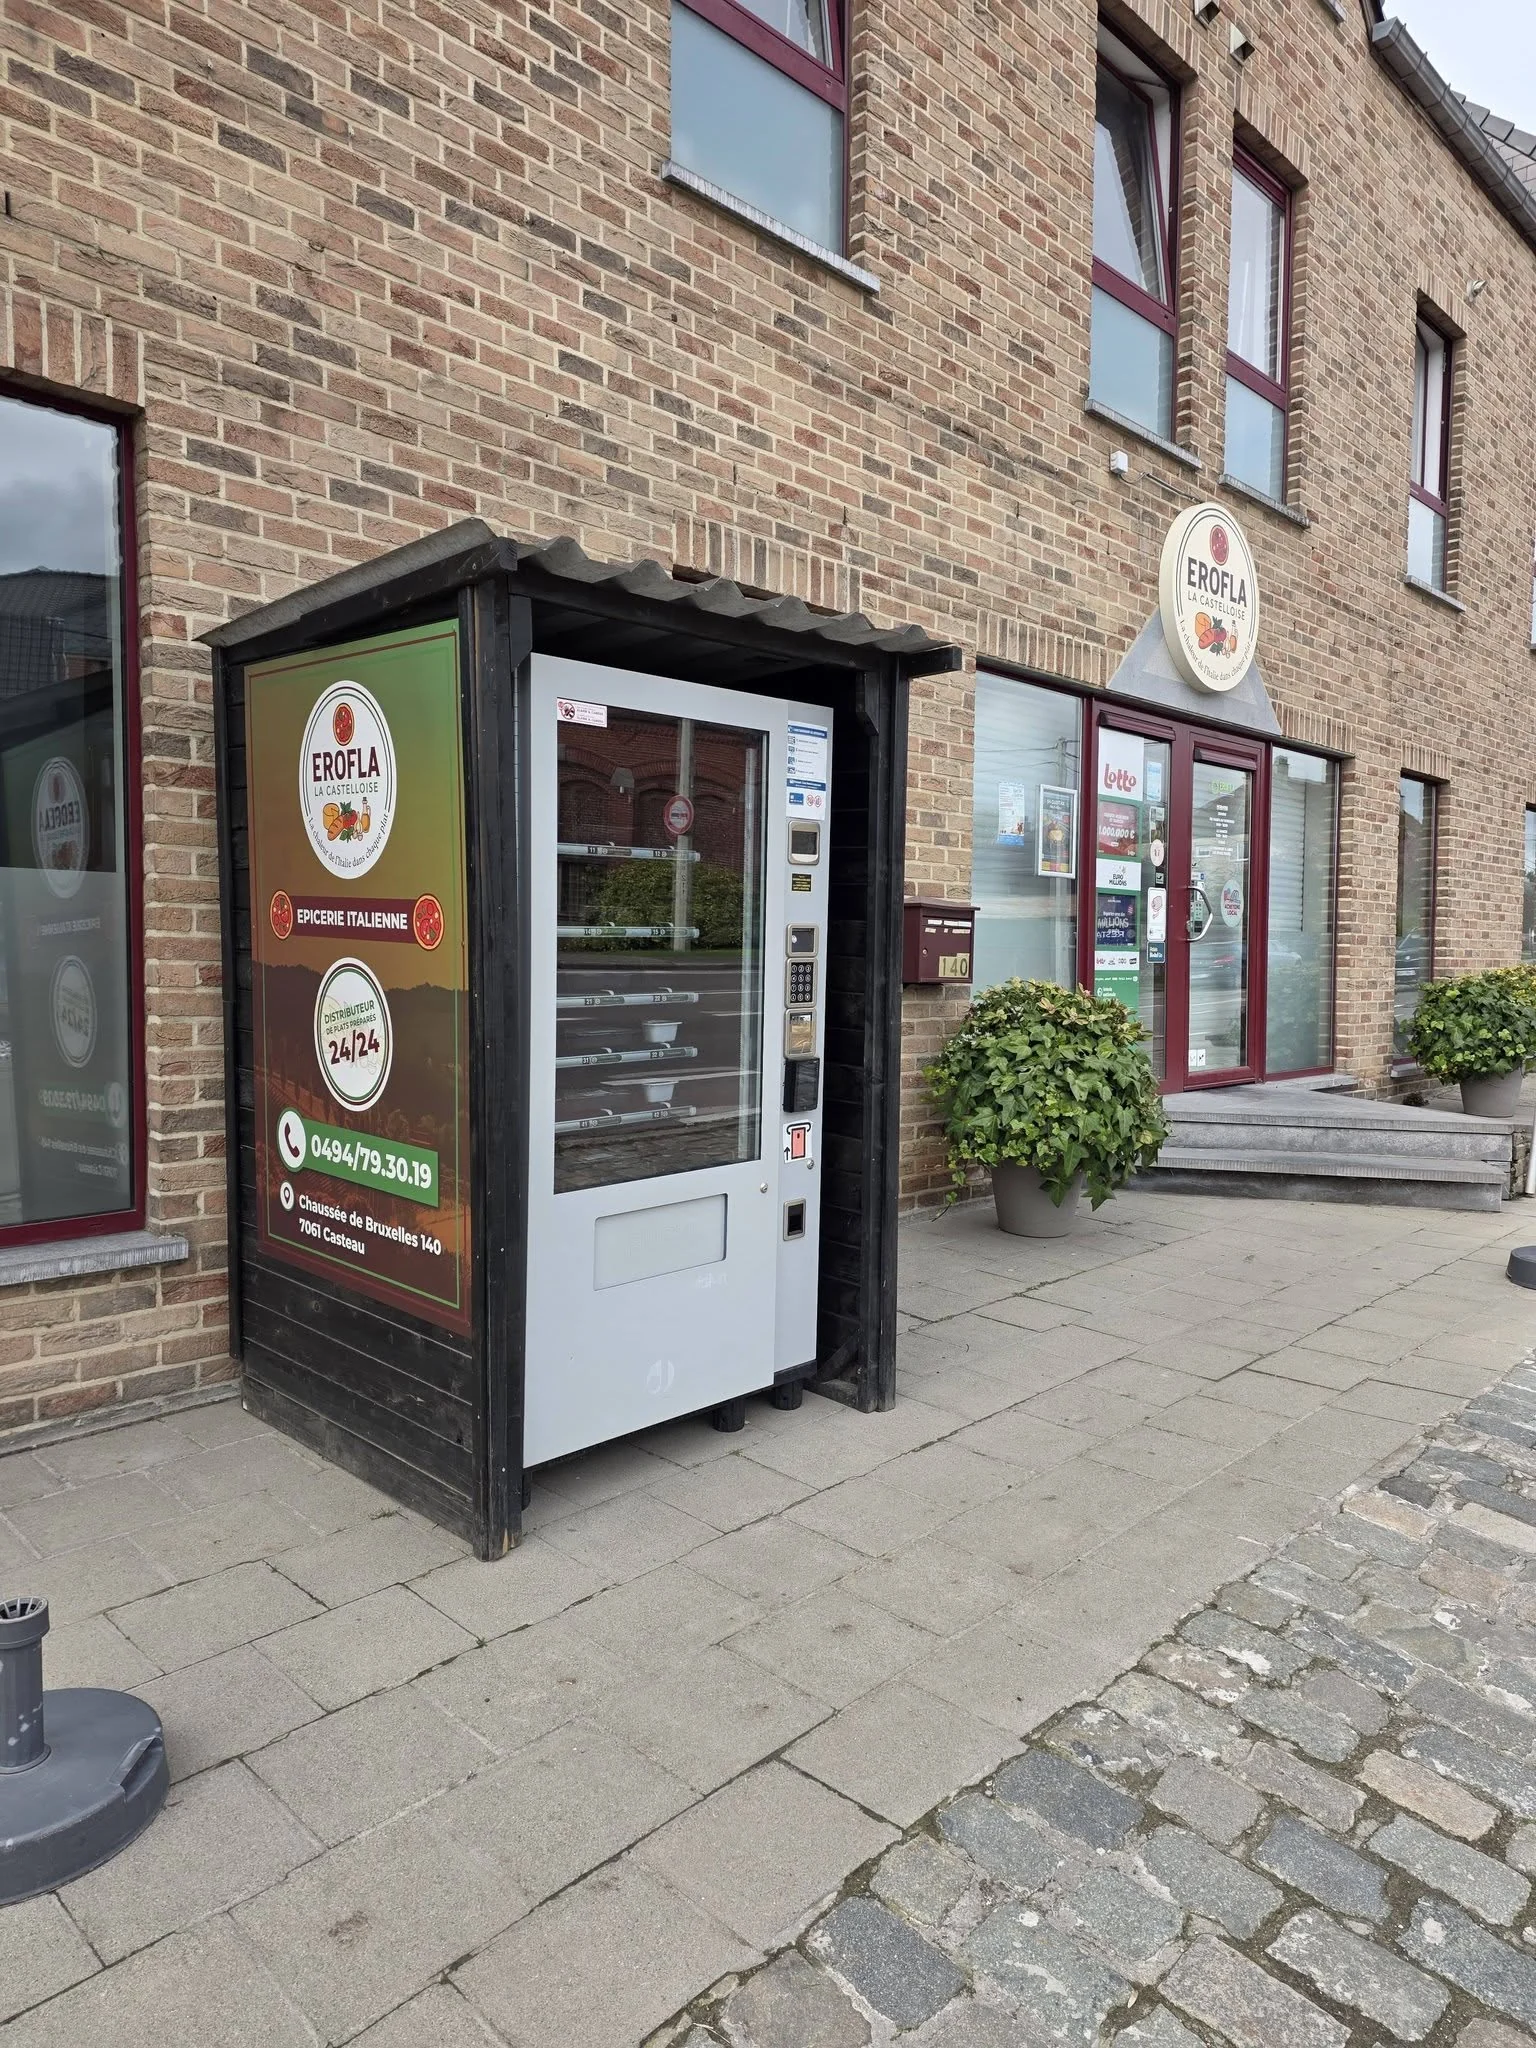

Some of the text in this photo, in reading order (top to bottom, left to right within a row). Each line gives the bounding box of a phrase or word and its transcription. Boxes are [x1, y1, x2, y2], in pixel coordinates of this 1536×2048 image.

[1187, 556, 1247, 608] EROFLA
[1188, 590, 1246, 621] LA CASTELLOISE
[312, 746, 381, 782] EROFLA
[314, 781, 379, 797] LA CASTELLOISE
[308, 817, 315, 830] La
[313, 831, 329, 856] chaleur
[328, 853, 335, 863] de
[352, 855, 366, 867] dans
[365, 832, 382, 859] chaque
[380, 813, 389, 835] plat
[1108, 878, 1127, 887] MILLIONS
[297, 908, 408, 931] EPICERIE ITALIENNE
[942, 957, 968, 977] 140
[324, 1000, 376, 1025] DISTRIBUTEUR
[326, 1013, 377, 1035] DE PLATS PRÉPARÉS
[328, 1029, 380, 1065] 24/24
[311, 1134, 433, 1190] 0494/79.30.19
[299, 1194, 442, 1256] Chaussée de Bruxelles 140
[299, 1218, 365, 1256] 7061 Casteau
